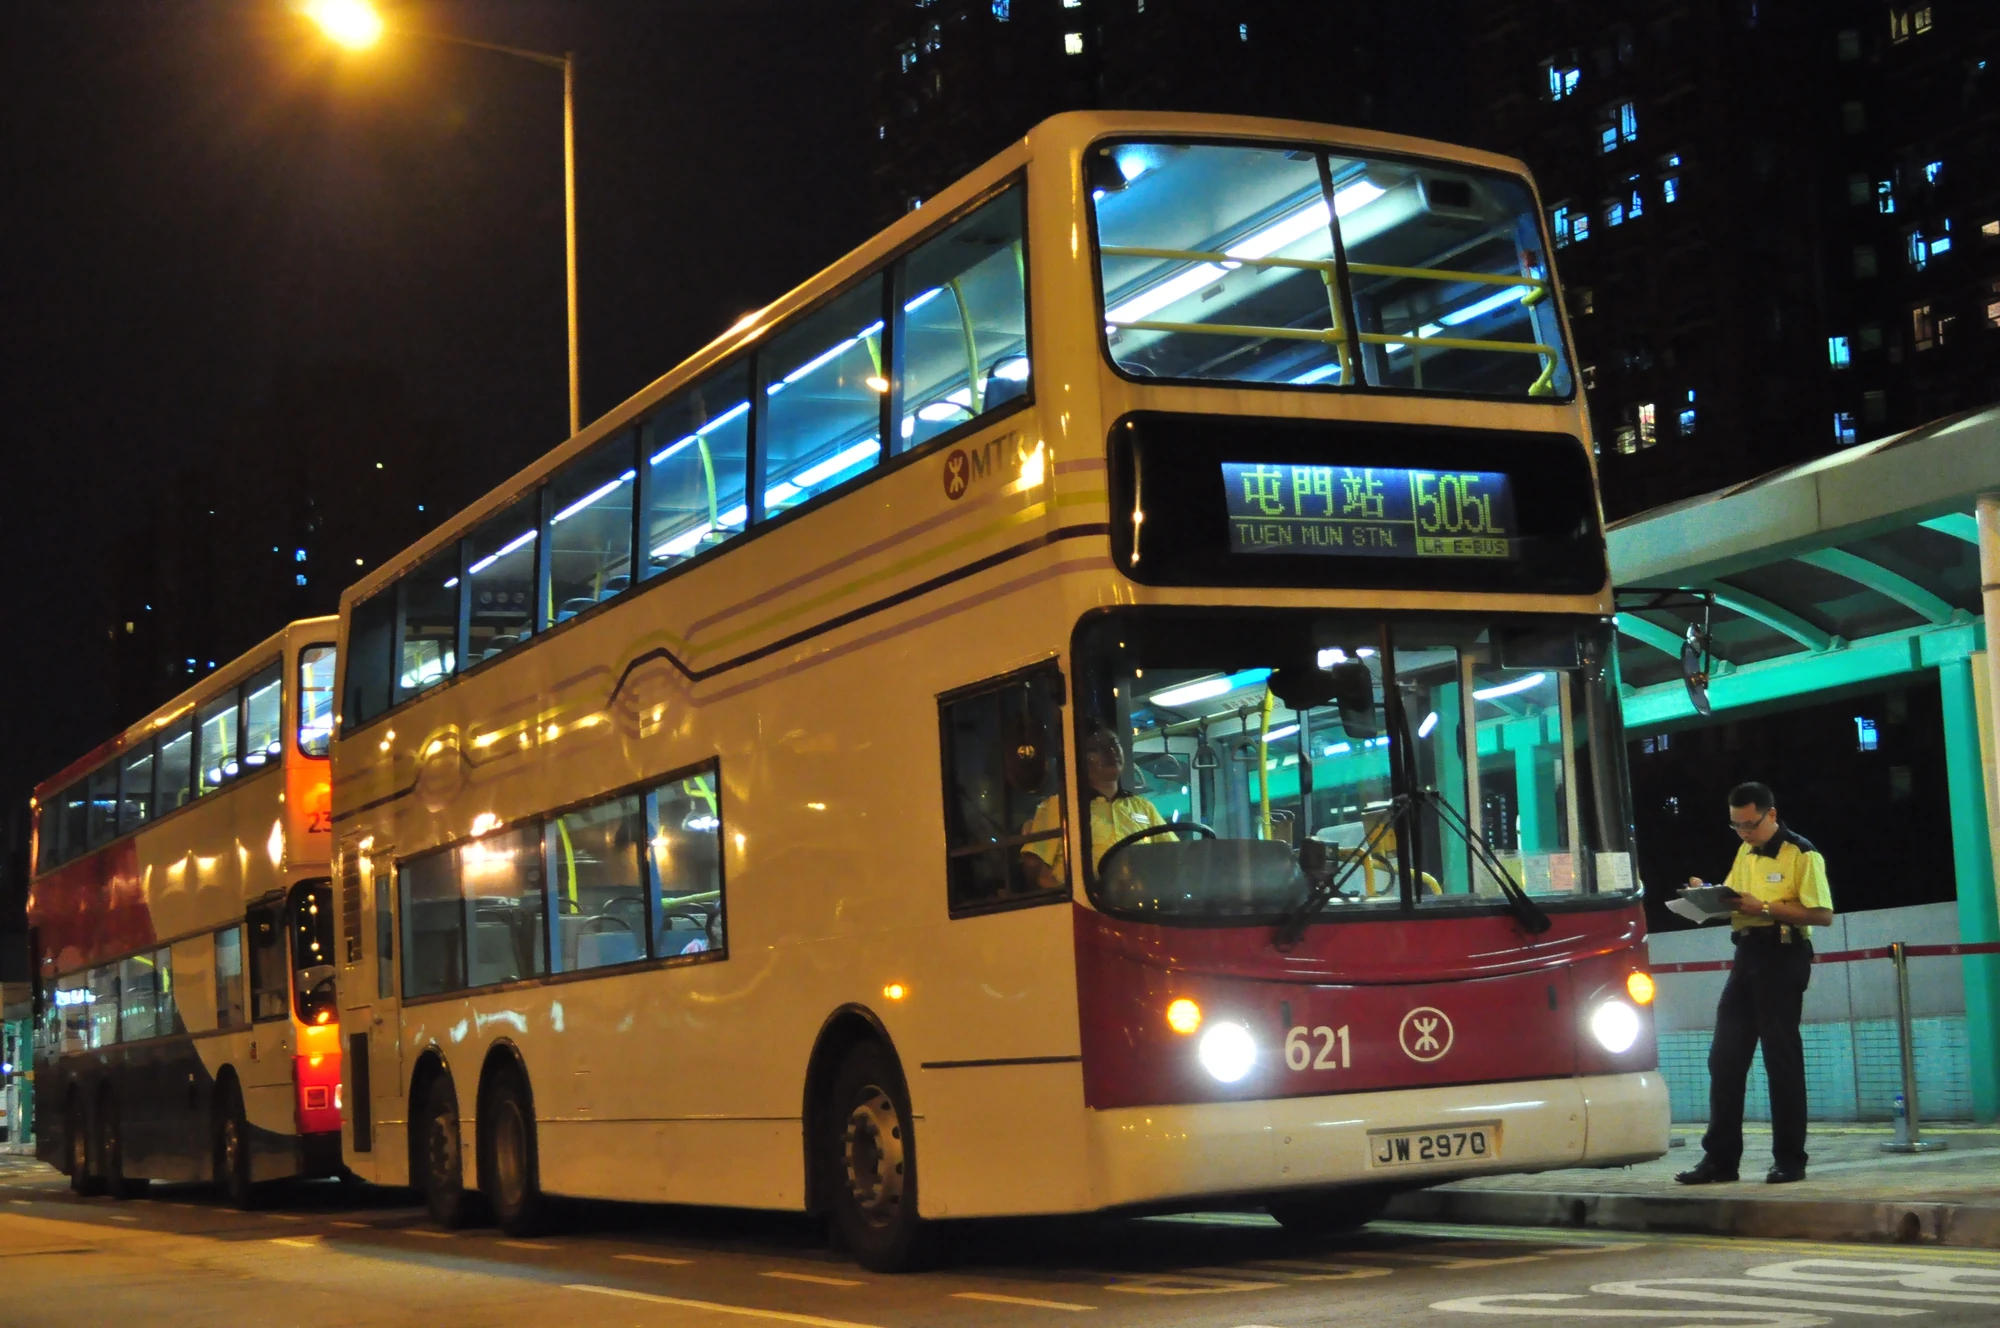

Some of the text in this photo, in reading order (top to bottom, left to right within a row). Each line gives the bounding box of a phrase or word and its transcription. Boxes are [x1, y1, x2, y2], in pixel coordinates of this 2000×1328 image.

[1240, 464, 1384, 518] 屯門站
[1416, 473, 1505, 533] 505L
[1236, 523, 1397, 547] TUEN MUN STN.
[1285, 1024, 1351, 1072] 621
[1378, 1131, 1486, 1163] JW 2970
